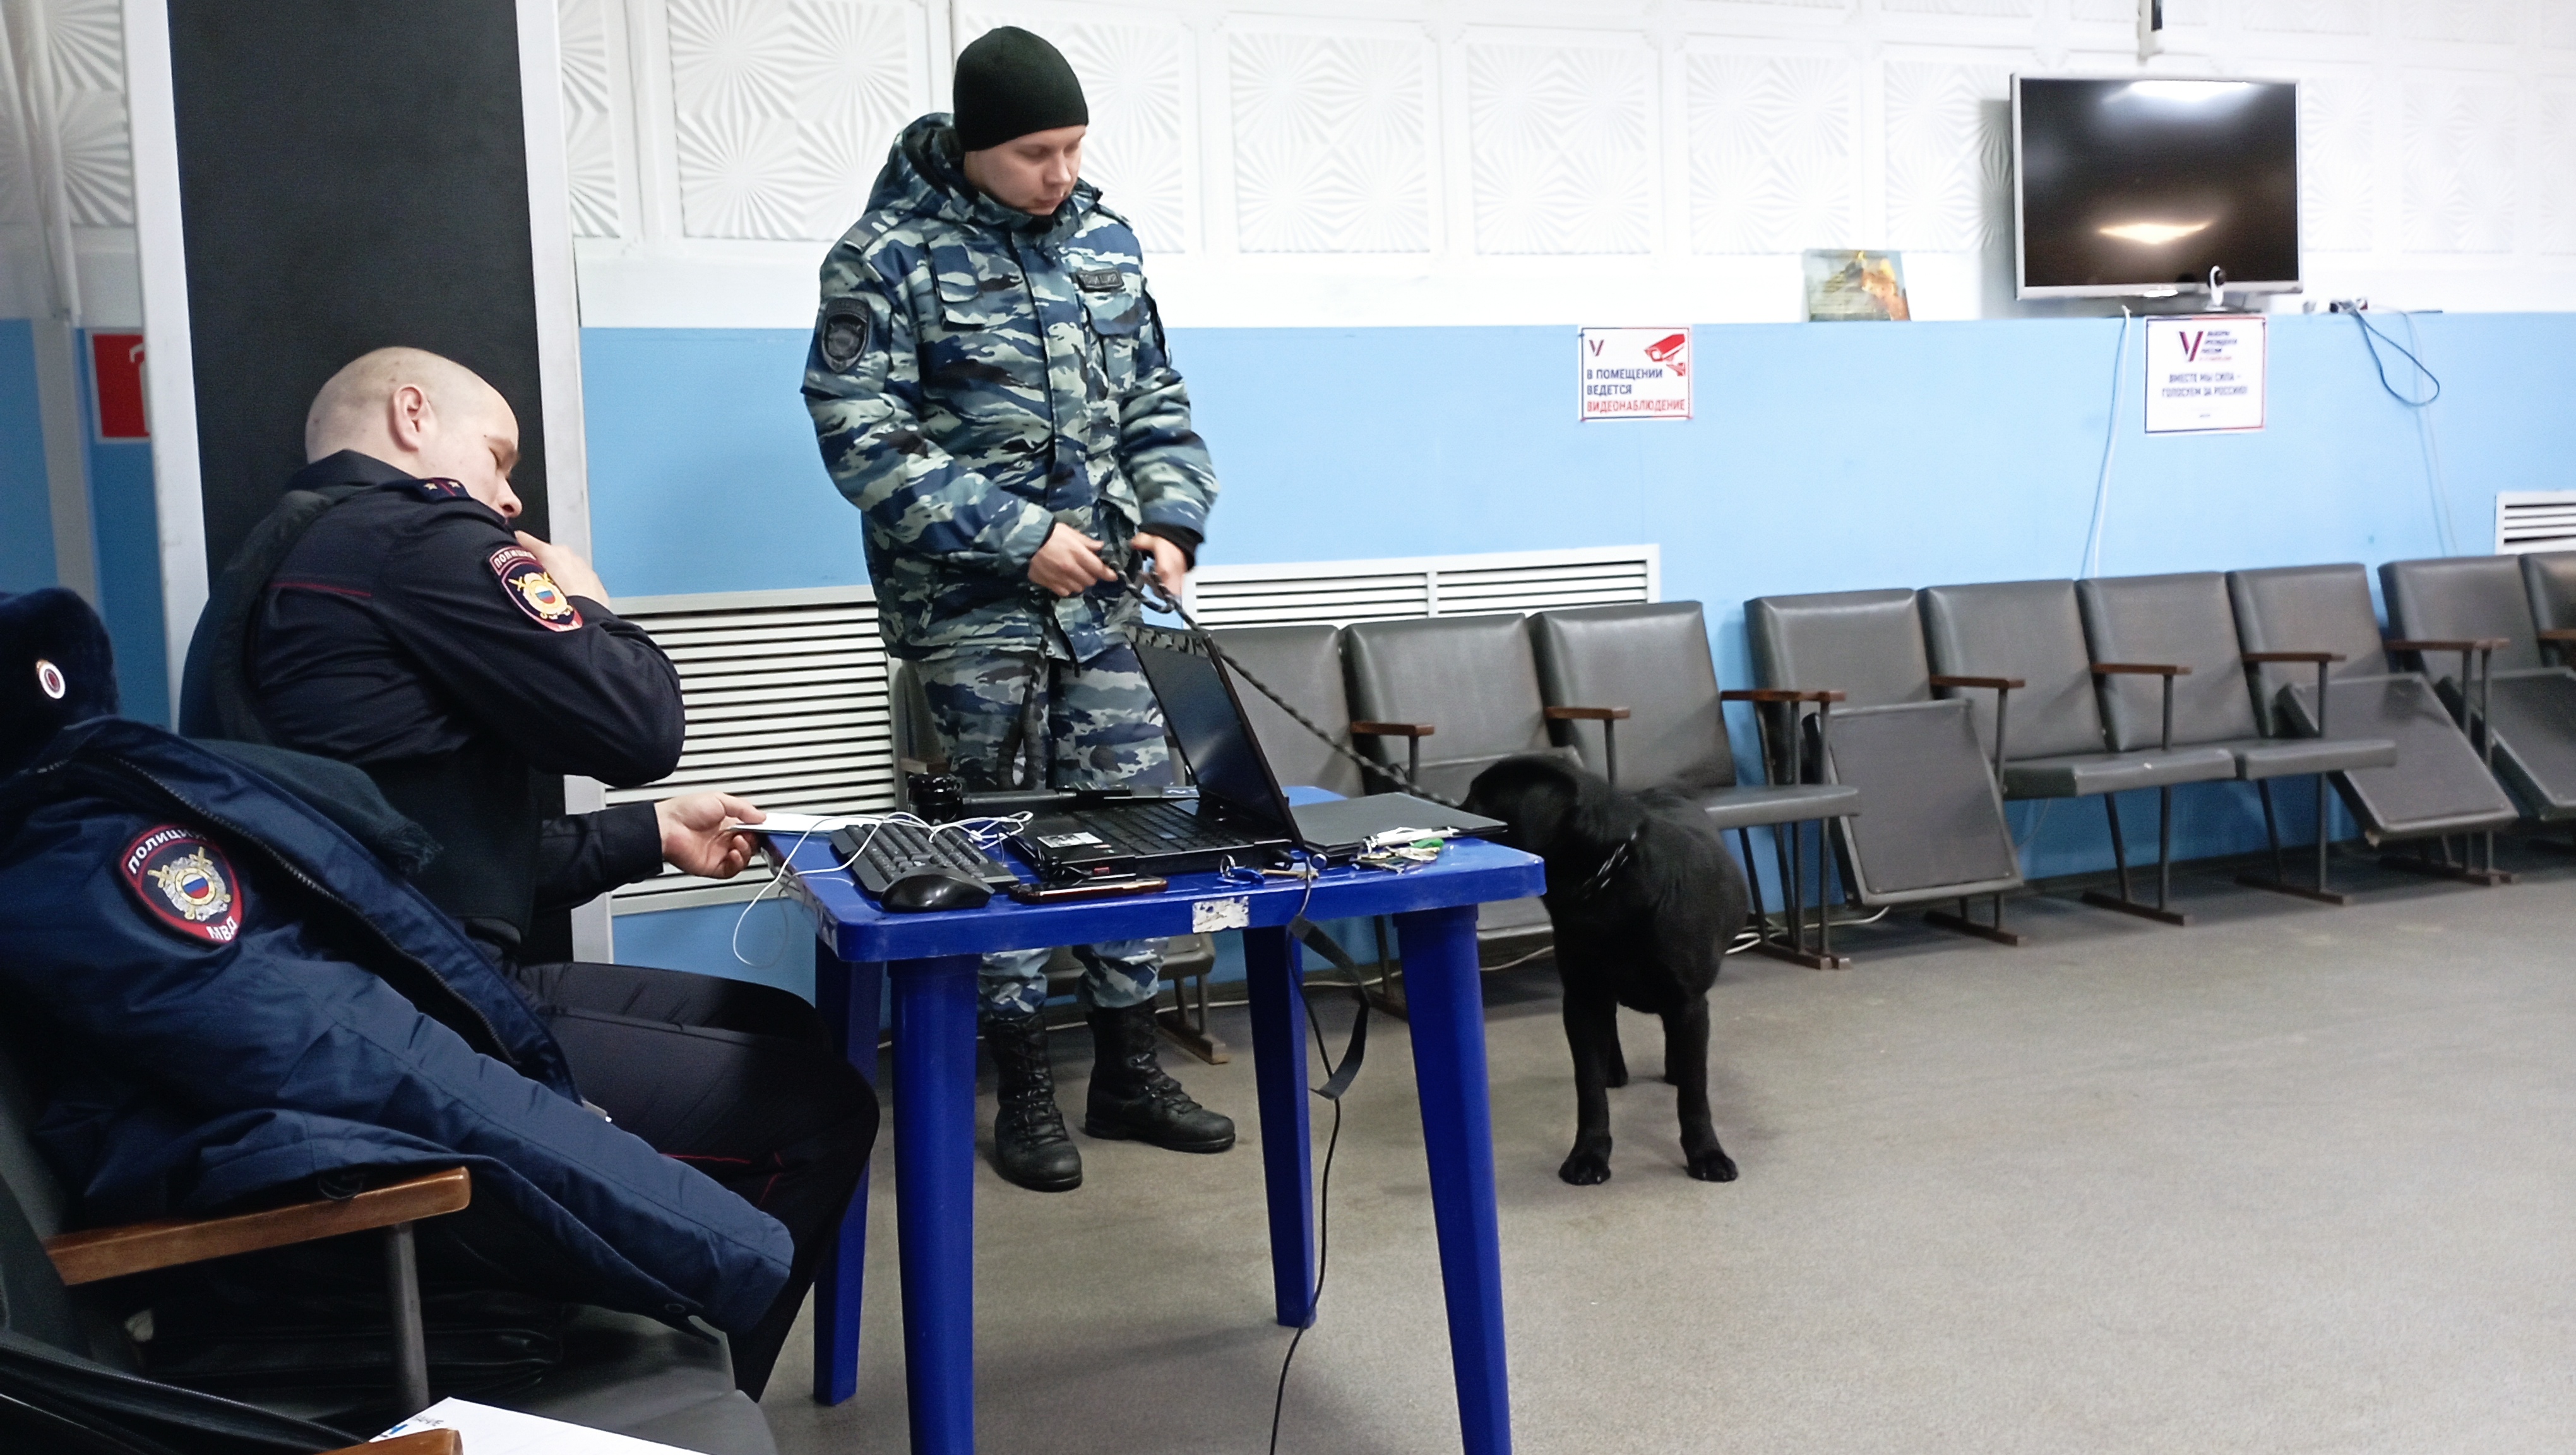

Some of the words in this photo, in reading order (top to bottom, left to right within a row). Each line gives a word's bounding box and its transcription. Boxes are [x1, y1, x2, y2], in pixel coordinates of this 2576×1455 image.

[1587, 369, 1592, 380] В
[1596, 368, 1663, 380] ПОМЕЩЕНИИ
[1587, 384, 1632, 396] ВЕДЕТСЯ
[1587, 399, 1686, 414] ВИДЕОНАБЛЮДЕНИЕ
[206, 916, 238, 941] МВД
